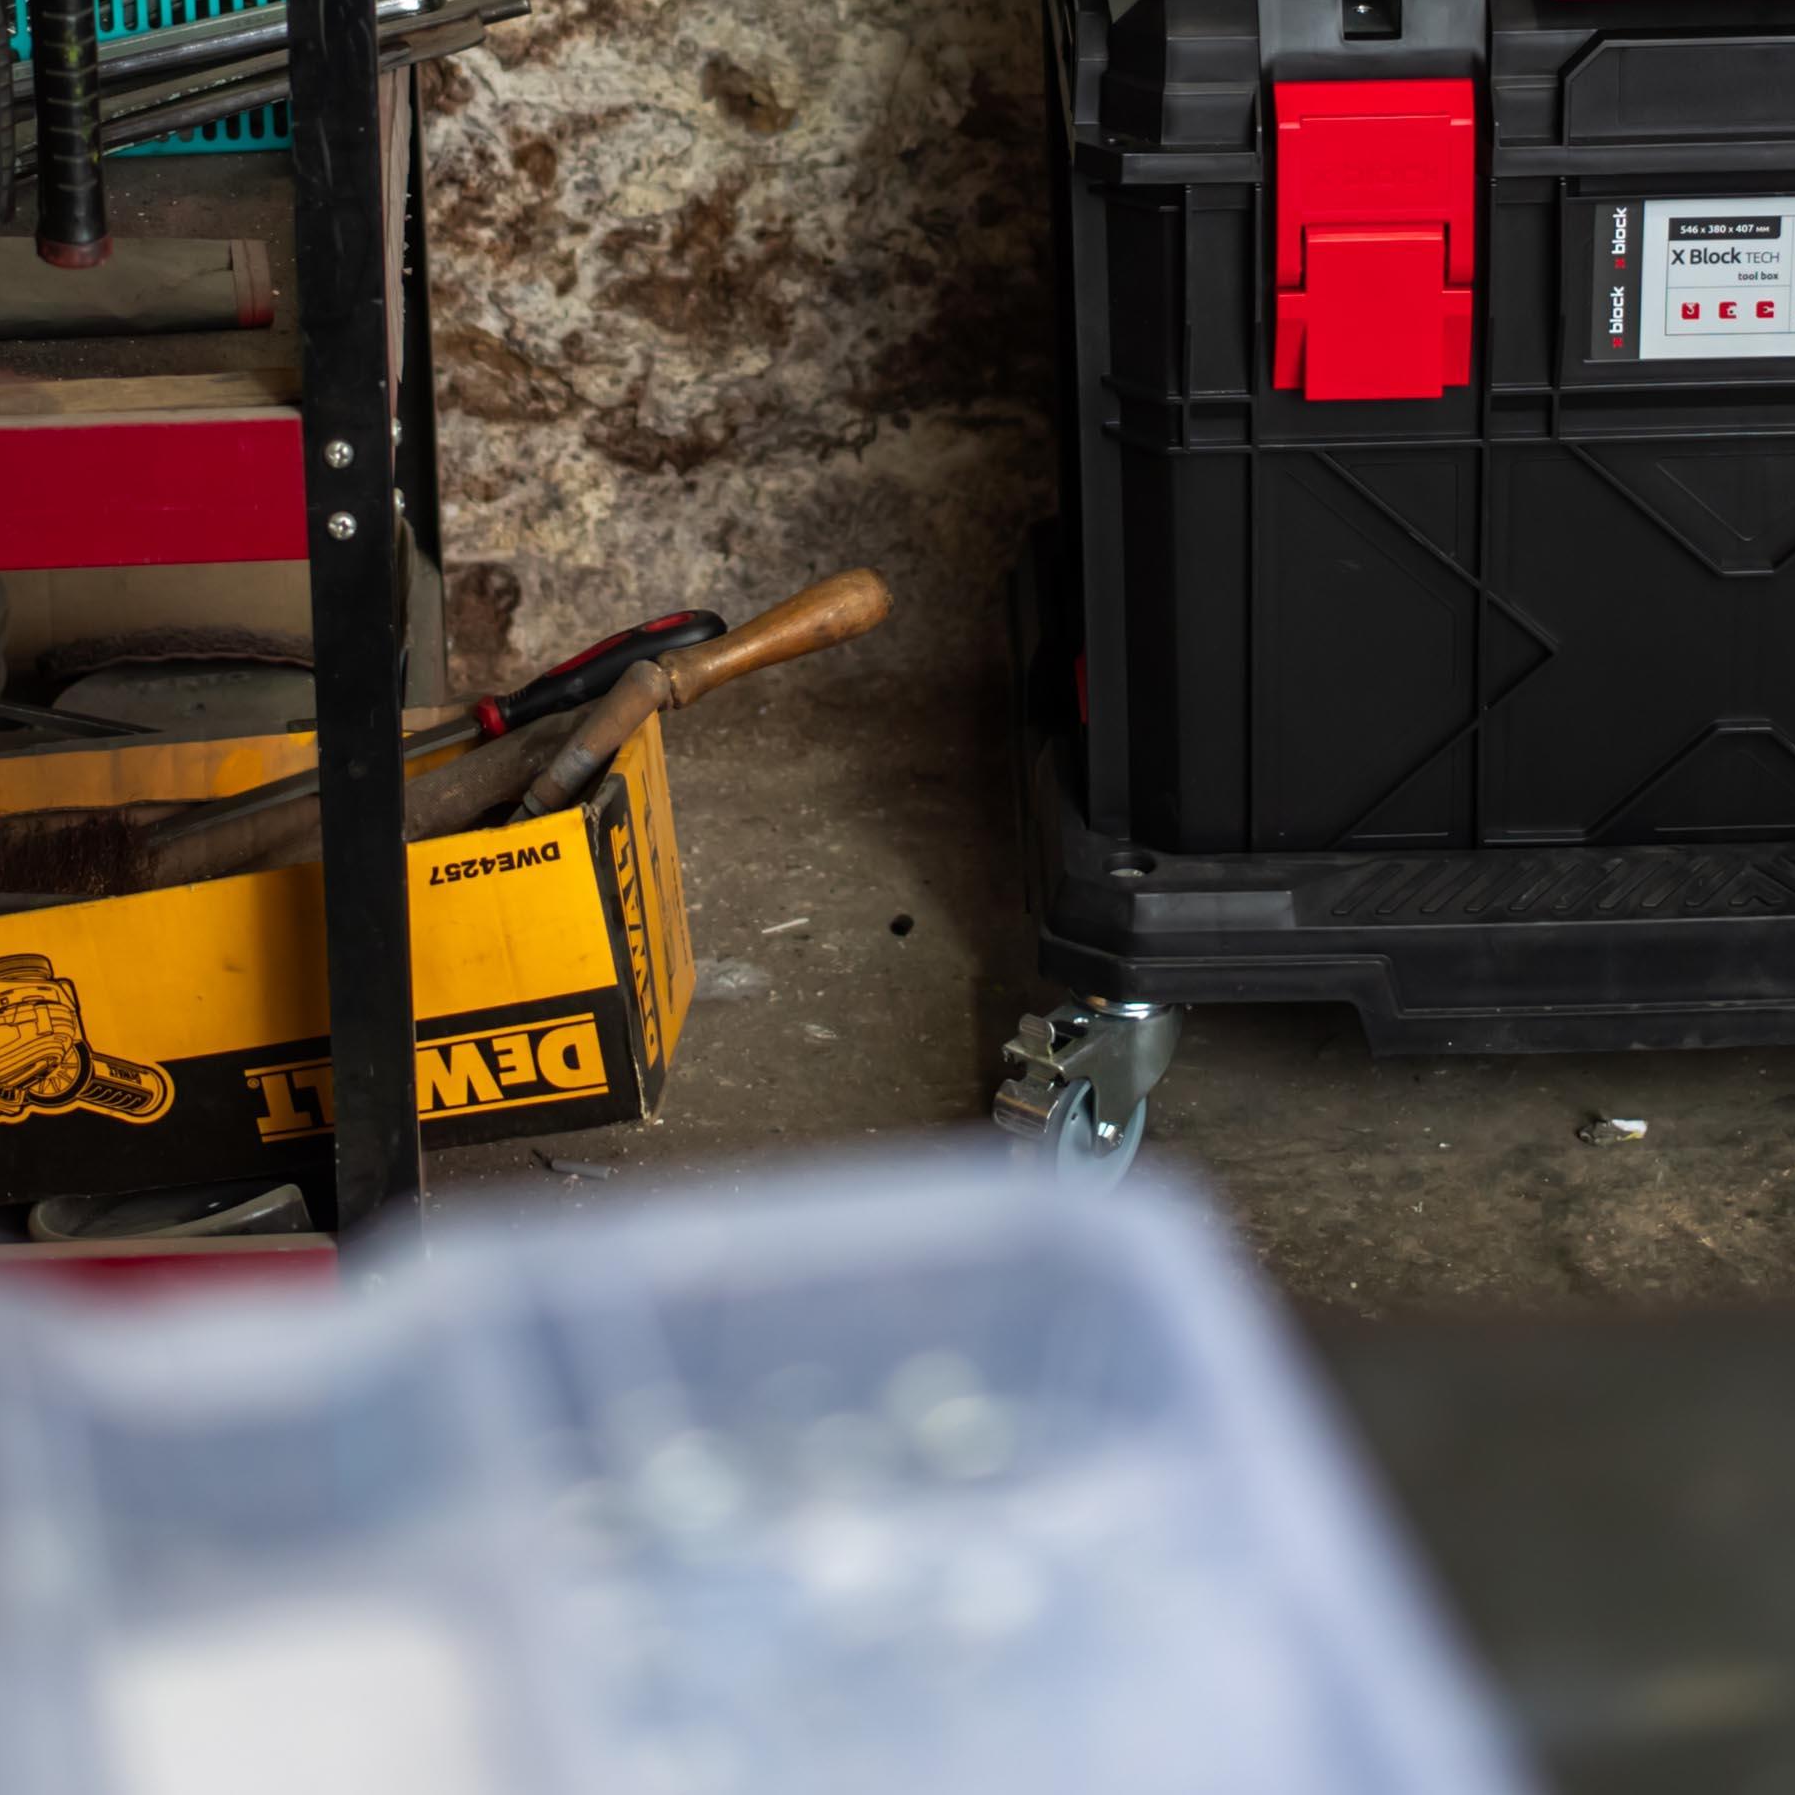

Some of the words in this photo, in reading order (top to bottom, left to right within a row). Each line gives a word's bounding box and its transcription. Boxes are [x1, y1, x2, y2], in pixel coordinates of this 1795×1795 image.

[1611, 206, 1628, 256] block
[1680, 224, 1698, 234] 546
[1708, 224, 1726, 234] 380
[1736, 224, 1754, 233] 407
[1671, 249, 1685, 265] X
[1690, 247, 1742, 265] Block
[1746, 251, 1780, 264] TECH
[1737, 271, 1758, 281] tool
[1760, 270, 1779, 280] box
[1608, 285, 1625, 335] block
[429, 841, 560, 887] DWE4257
